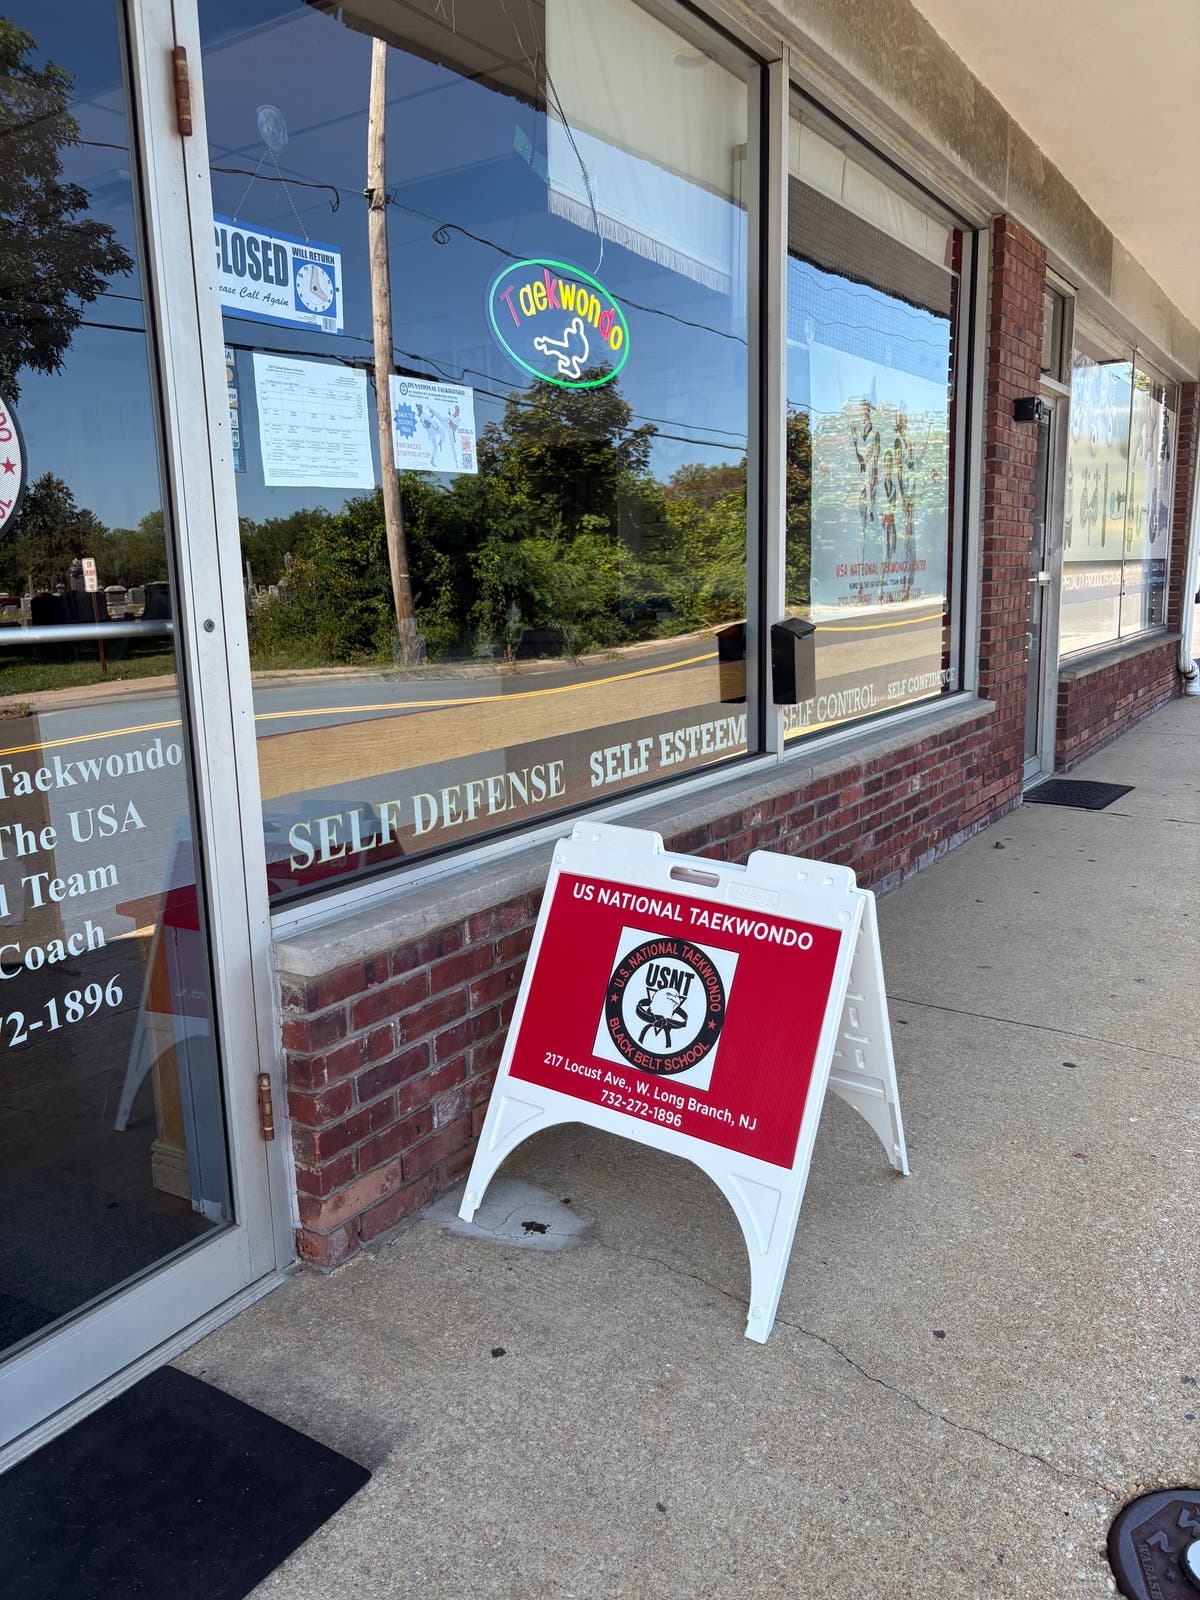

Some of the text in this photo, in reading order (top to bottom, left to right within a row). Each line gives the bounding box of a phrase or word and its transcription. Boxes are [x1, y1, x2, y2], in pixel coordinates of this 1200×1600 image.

[292, 247, 335, 265] WILL RETURN
[239, 286, 260, 300] Call
[262, 293, 290, 307] Again
[499, 268, 623, 350] Taekwondo
[836, 564, 848, 578] USA
[850, 562, 879, 576] NATIONAL
[782, 699, 814, 732] SELF
[817, 684, 877, 722] CONTROL
[887, 679, 908, 700] SELF
[0, 738, 183, 801] Taekwondo
[288, 713, 748, 873] SELF DEFENSE SELF ESTEEM
[0, 800, 147, 862] The USA
[21, 864, 120, 909] Team
[573, 882, 813, 951] US NATIONAL TAEKWONDO
[0, 920, 107, 980] Coach
[614, 942, 721, 1012] U.S. NATIONAL TAEKWONDO
[0, 974, 124, 1047] 2-1896
[645, 963, 696, 998] USNT
[609, 1017, 710, 1071] BLACK BELT SCHOOL
[543, 1052, 757, 1131] 217 Locust Ave., W. Long Branch, NJ
[600, 1089, 682, 1127] 732-272-1896
